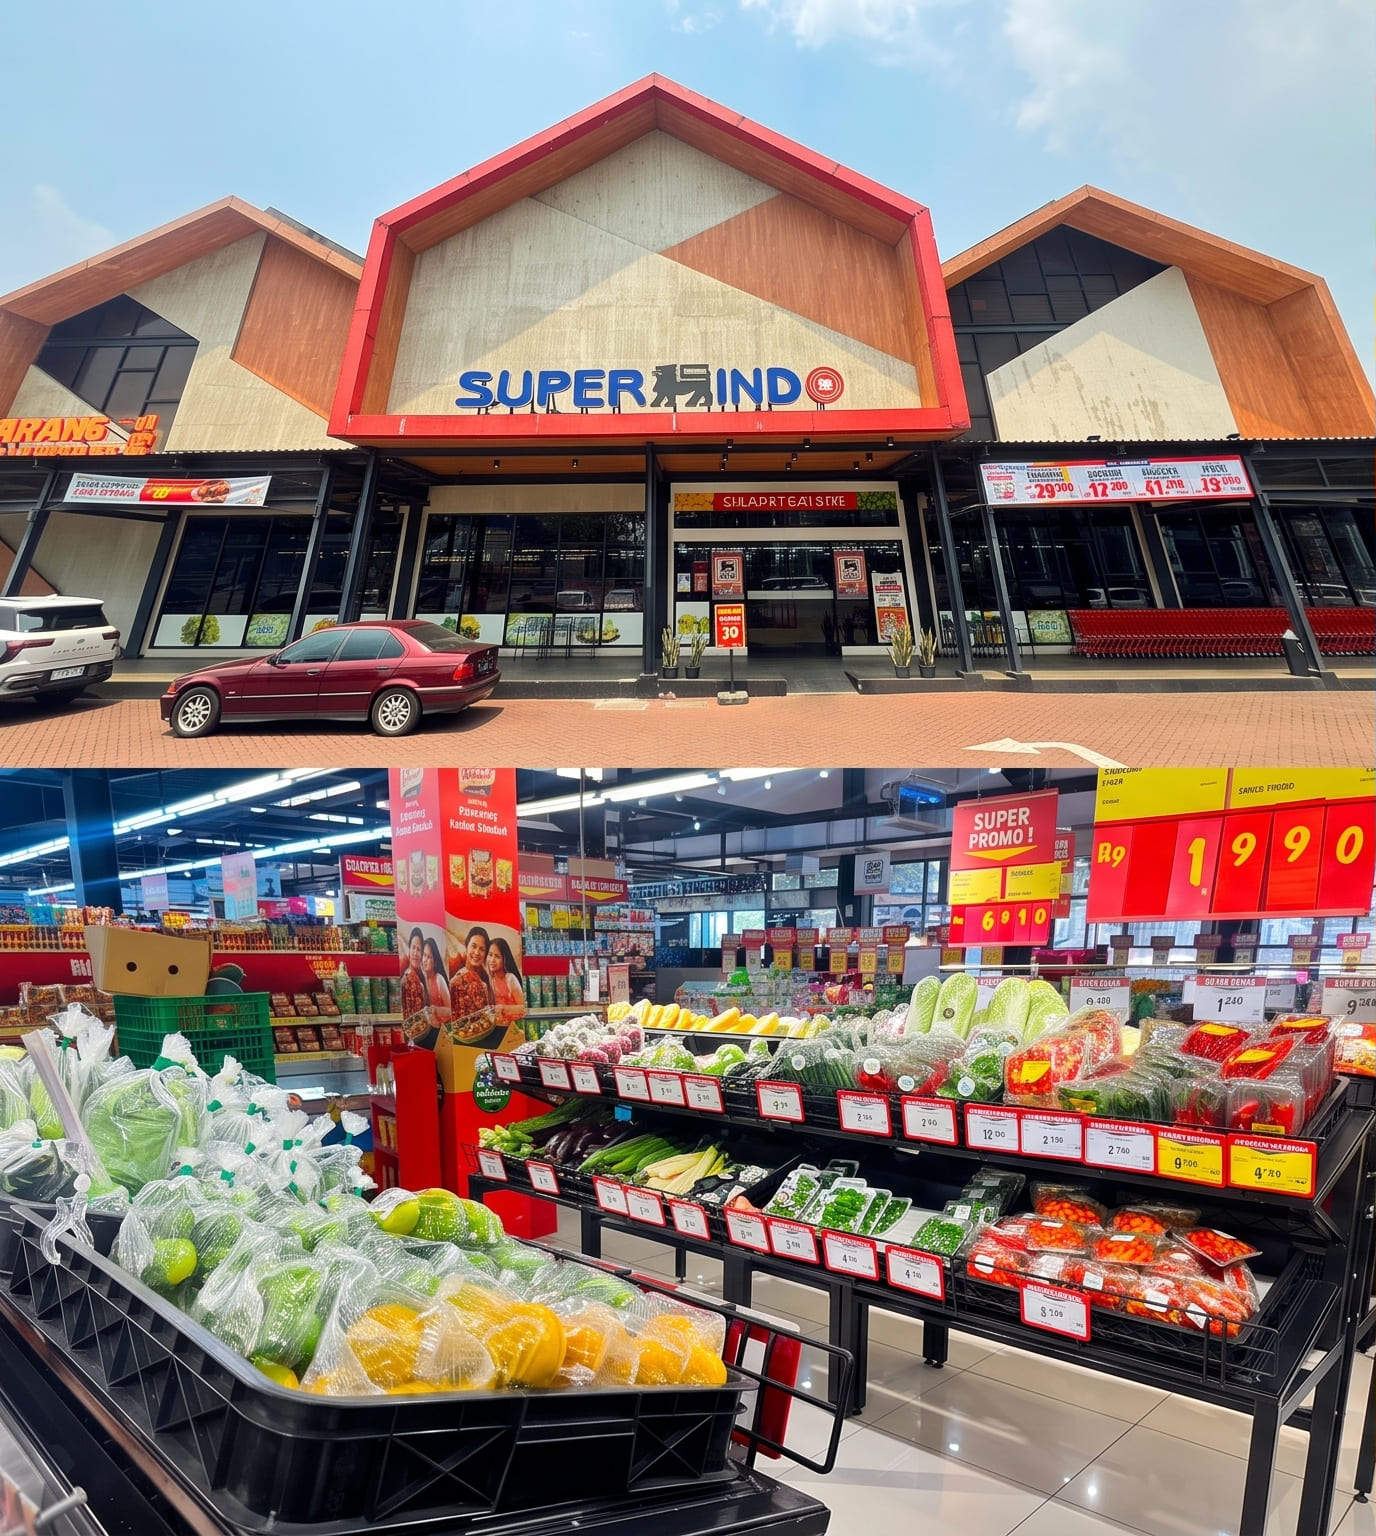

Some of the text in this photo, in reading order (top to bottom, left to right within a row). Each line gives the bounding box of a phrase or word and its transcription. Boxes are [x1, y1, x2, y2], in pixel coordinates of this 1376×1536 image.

[455, 369, 647, 409] SUPER
[974, 807, 1030, 831] SUPER
[968, 829, 1024, 849] PROMO
